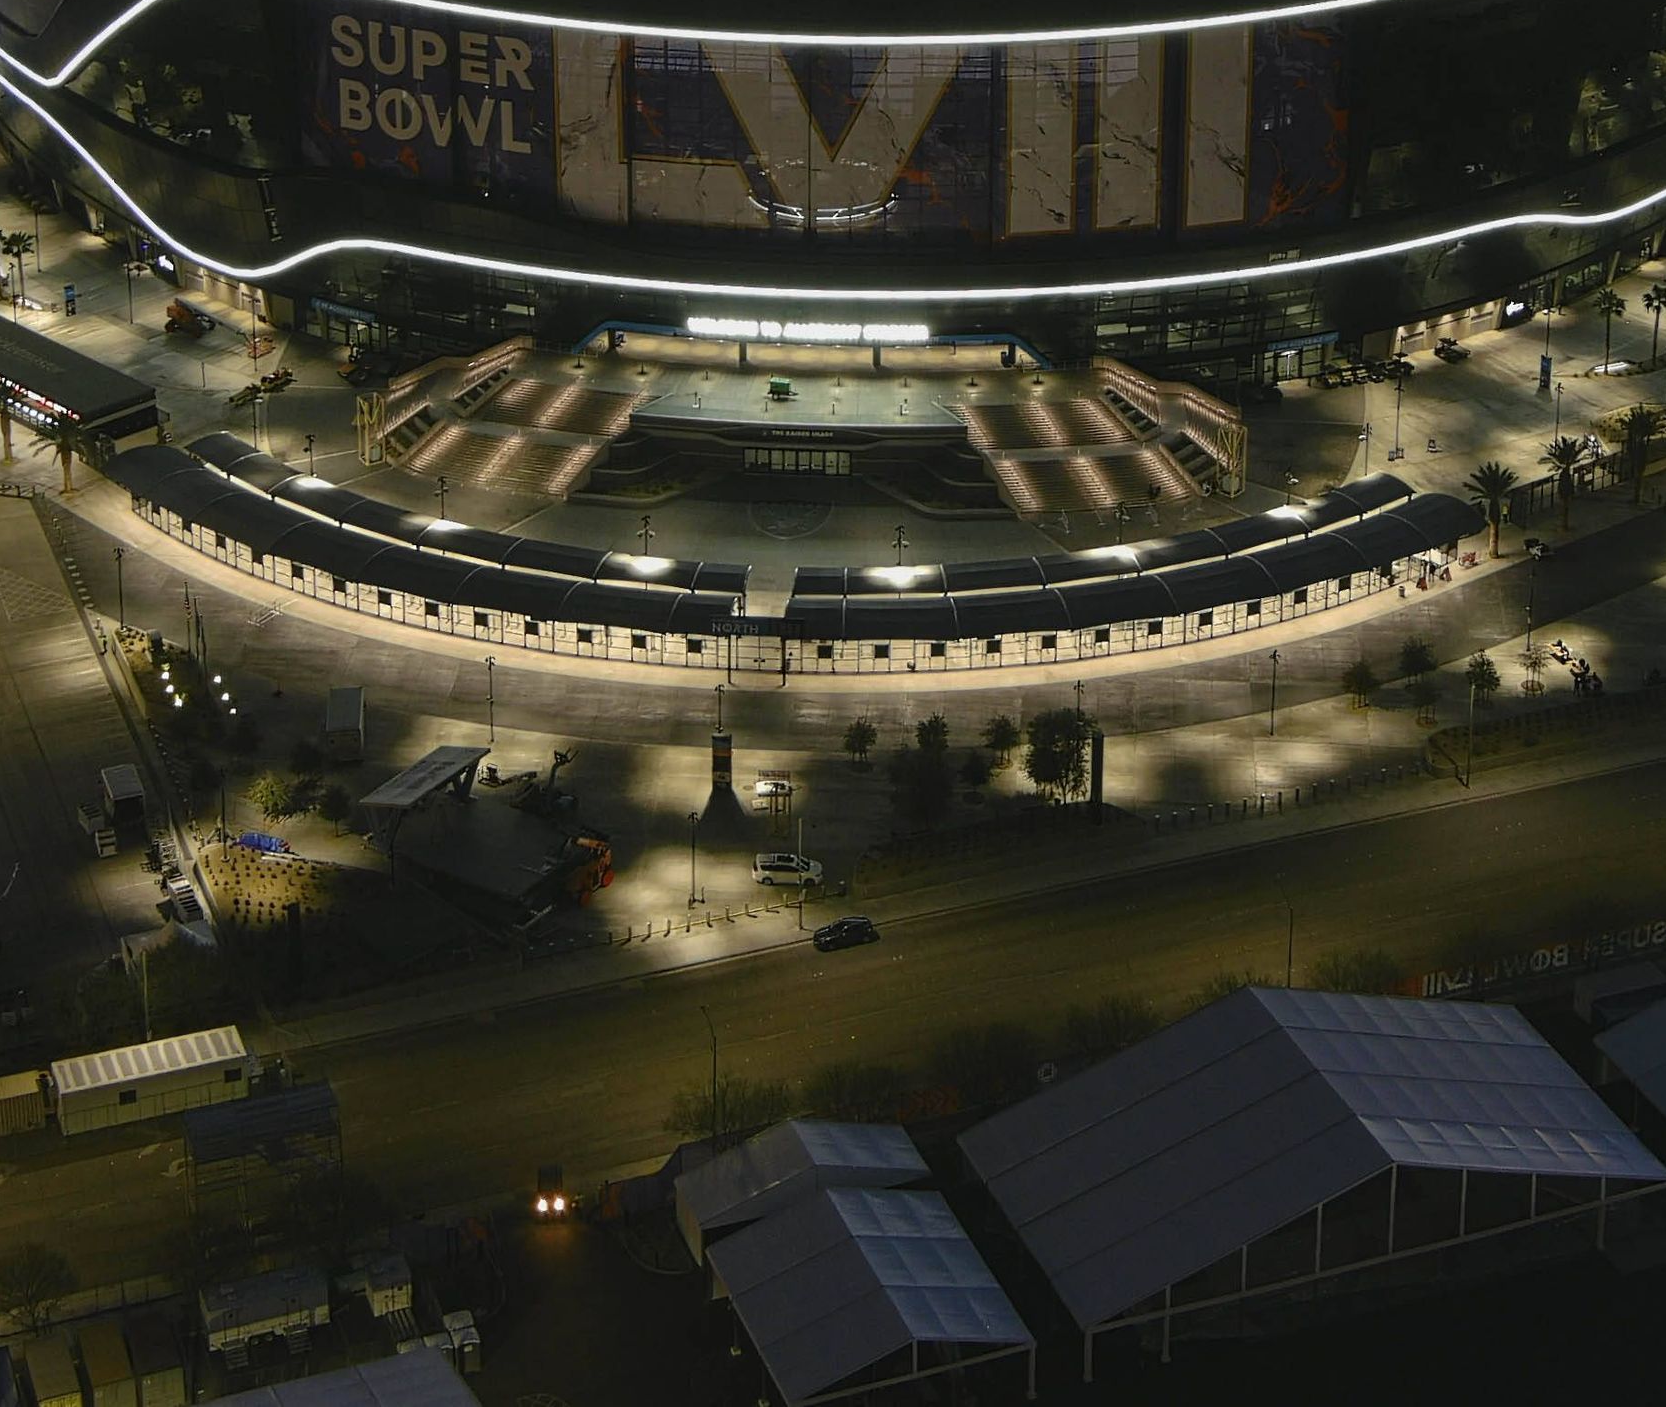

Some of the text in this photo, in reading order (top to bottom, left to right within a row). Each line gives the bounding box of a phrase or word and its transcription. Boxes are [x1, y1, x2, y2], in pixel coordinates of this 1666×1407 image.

[331, 15, 535, 91] SUPER
[339, 78, 533, 154] BOWL
[552, 26, 1254, 236] LVIII
[712, 622, 759, 634] NORTH
